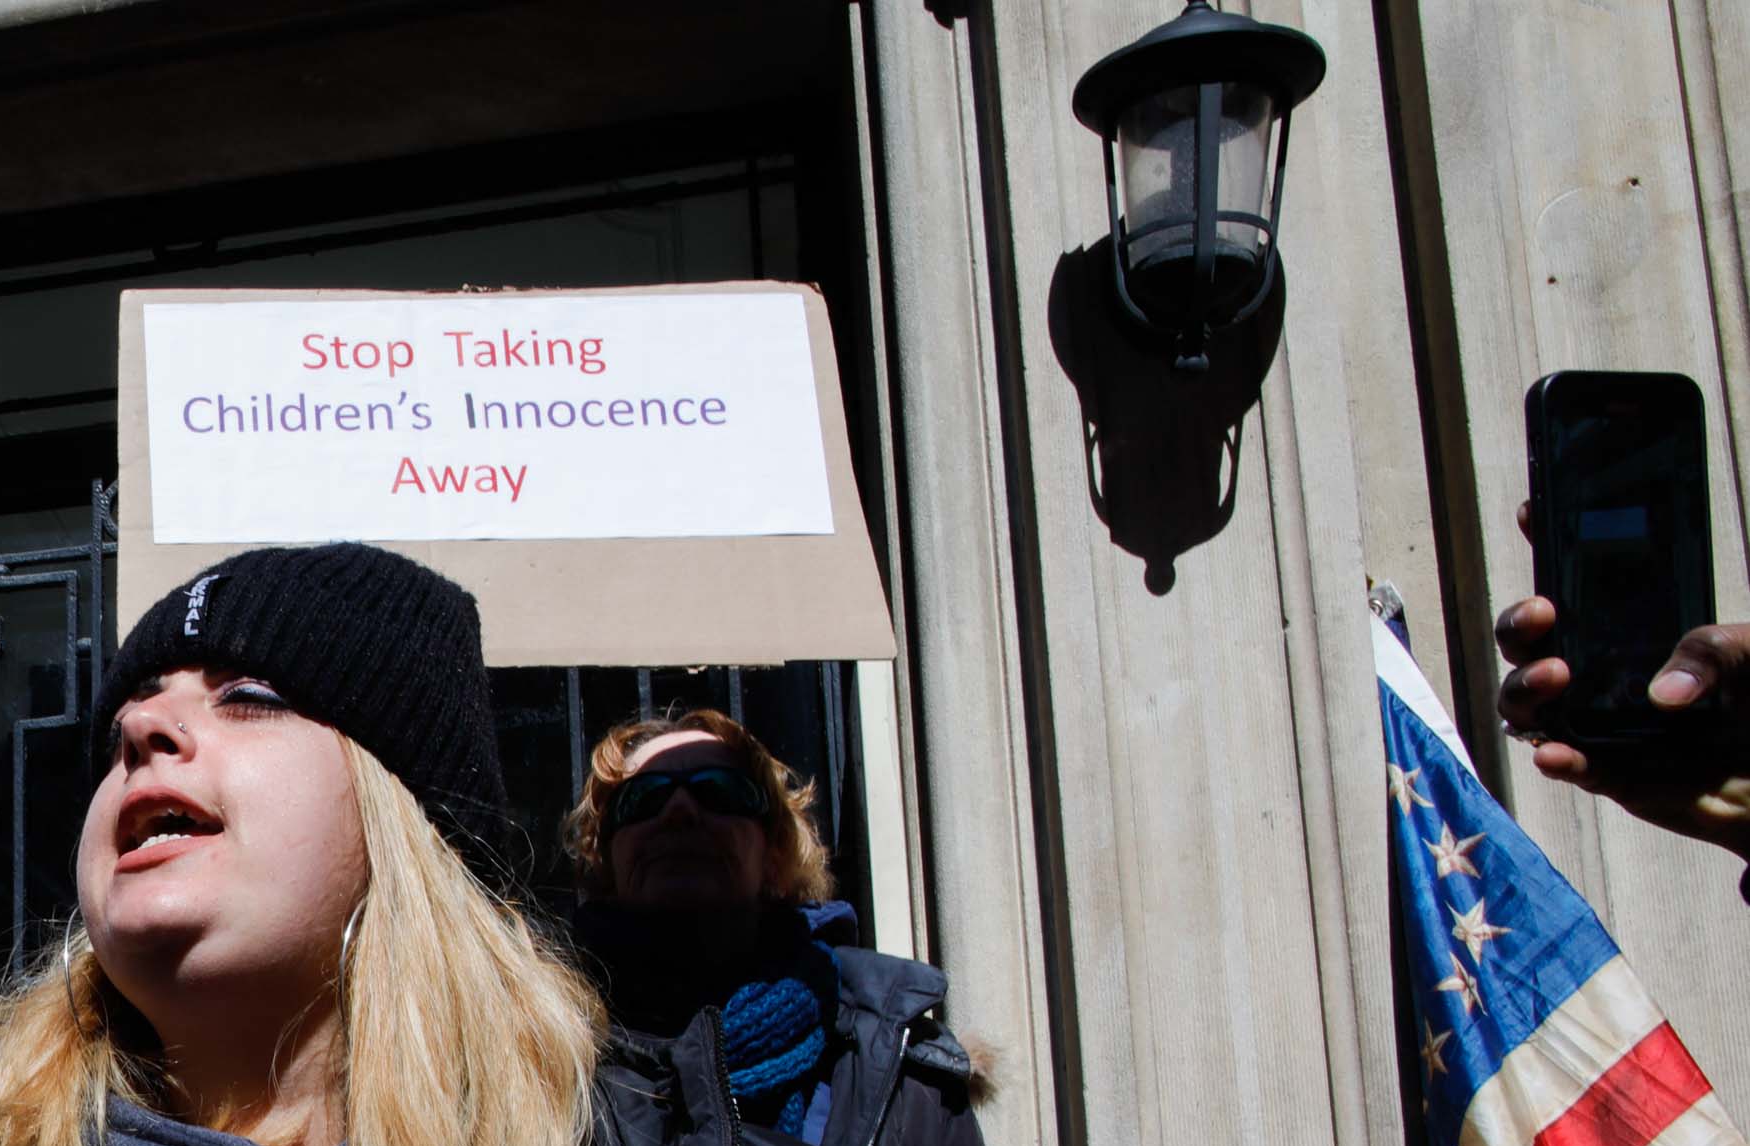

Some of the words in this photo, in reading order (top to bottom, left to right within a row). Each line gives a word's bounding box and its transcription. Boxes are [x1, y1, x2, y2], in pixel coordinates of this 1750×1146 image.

[300, 332, 415, 377] Stop
[442, 329, 608, 375] Taking
[182, 392, 433, 433] Children’s
[464, 391, 728, 430] Innocence
[390, 455, 529, 503] Away
